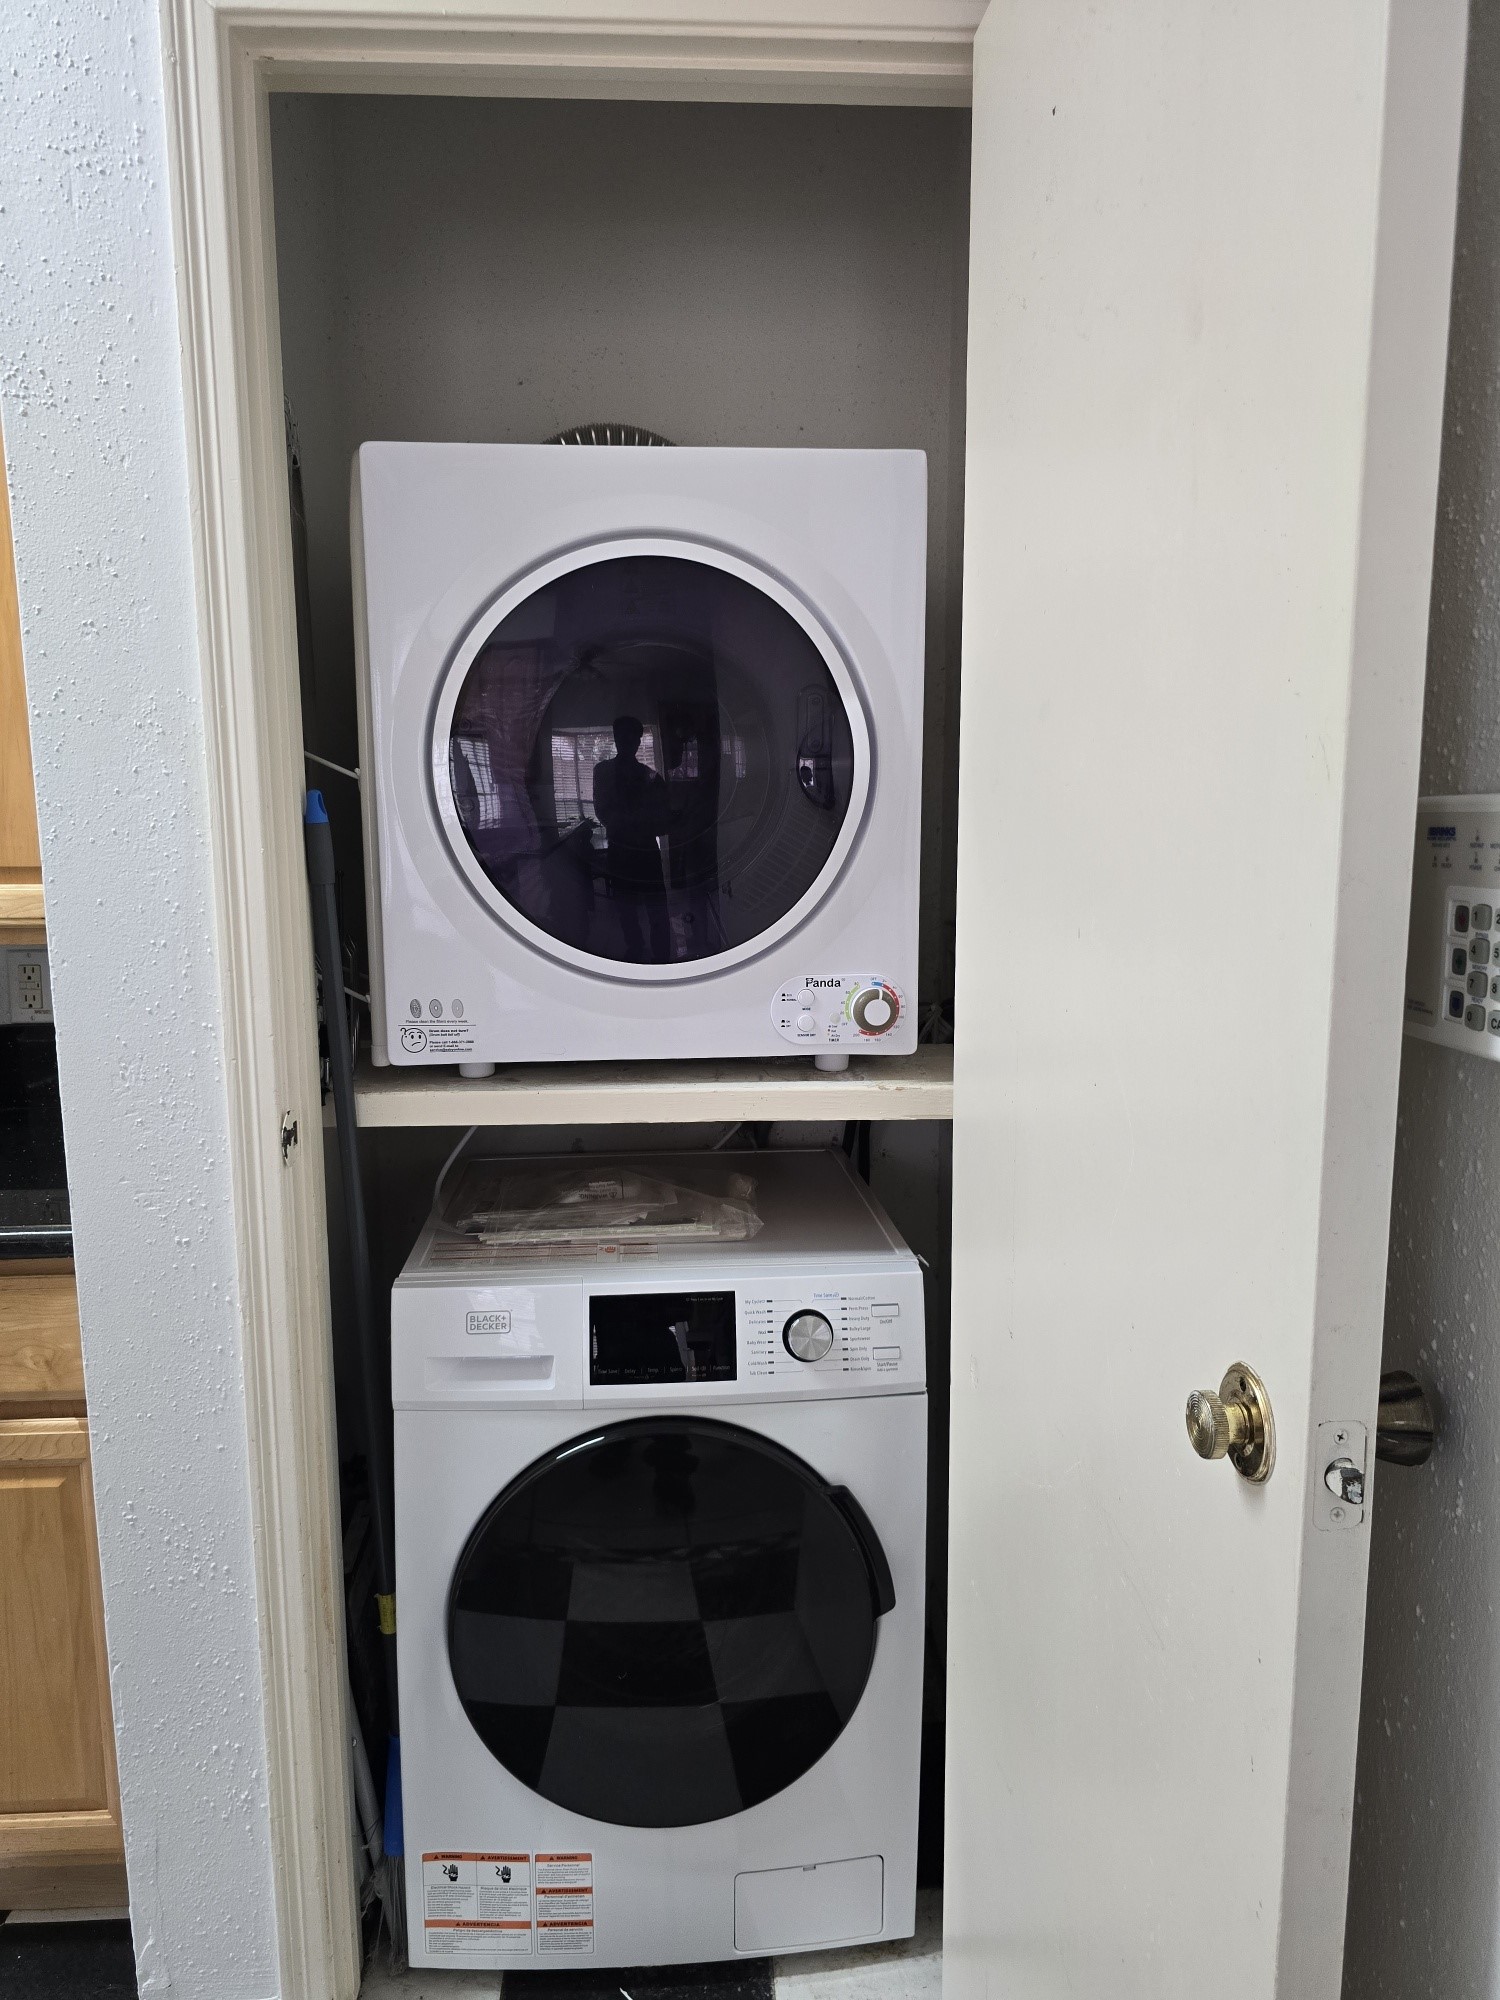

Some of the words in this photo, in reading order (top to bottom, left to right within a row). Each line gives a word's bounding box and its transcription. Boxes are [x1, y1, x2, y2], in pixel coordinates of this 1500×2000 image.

[1474, 911, 1477, 921] 1
[1471, 945, 1475, 955] 4
[1494, 948, 1499, 958] 5
[806, 978, 841, 987] Panda
[1469, 979, 1474, 988] 7
[1492, 983, 1497, 993] 8
[1467, 1011, 1472, 1021] 0
[470, 1314, 506, 1322] BLACK+
[470, 1322, 507, 1331] DECKER
